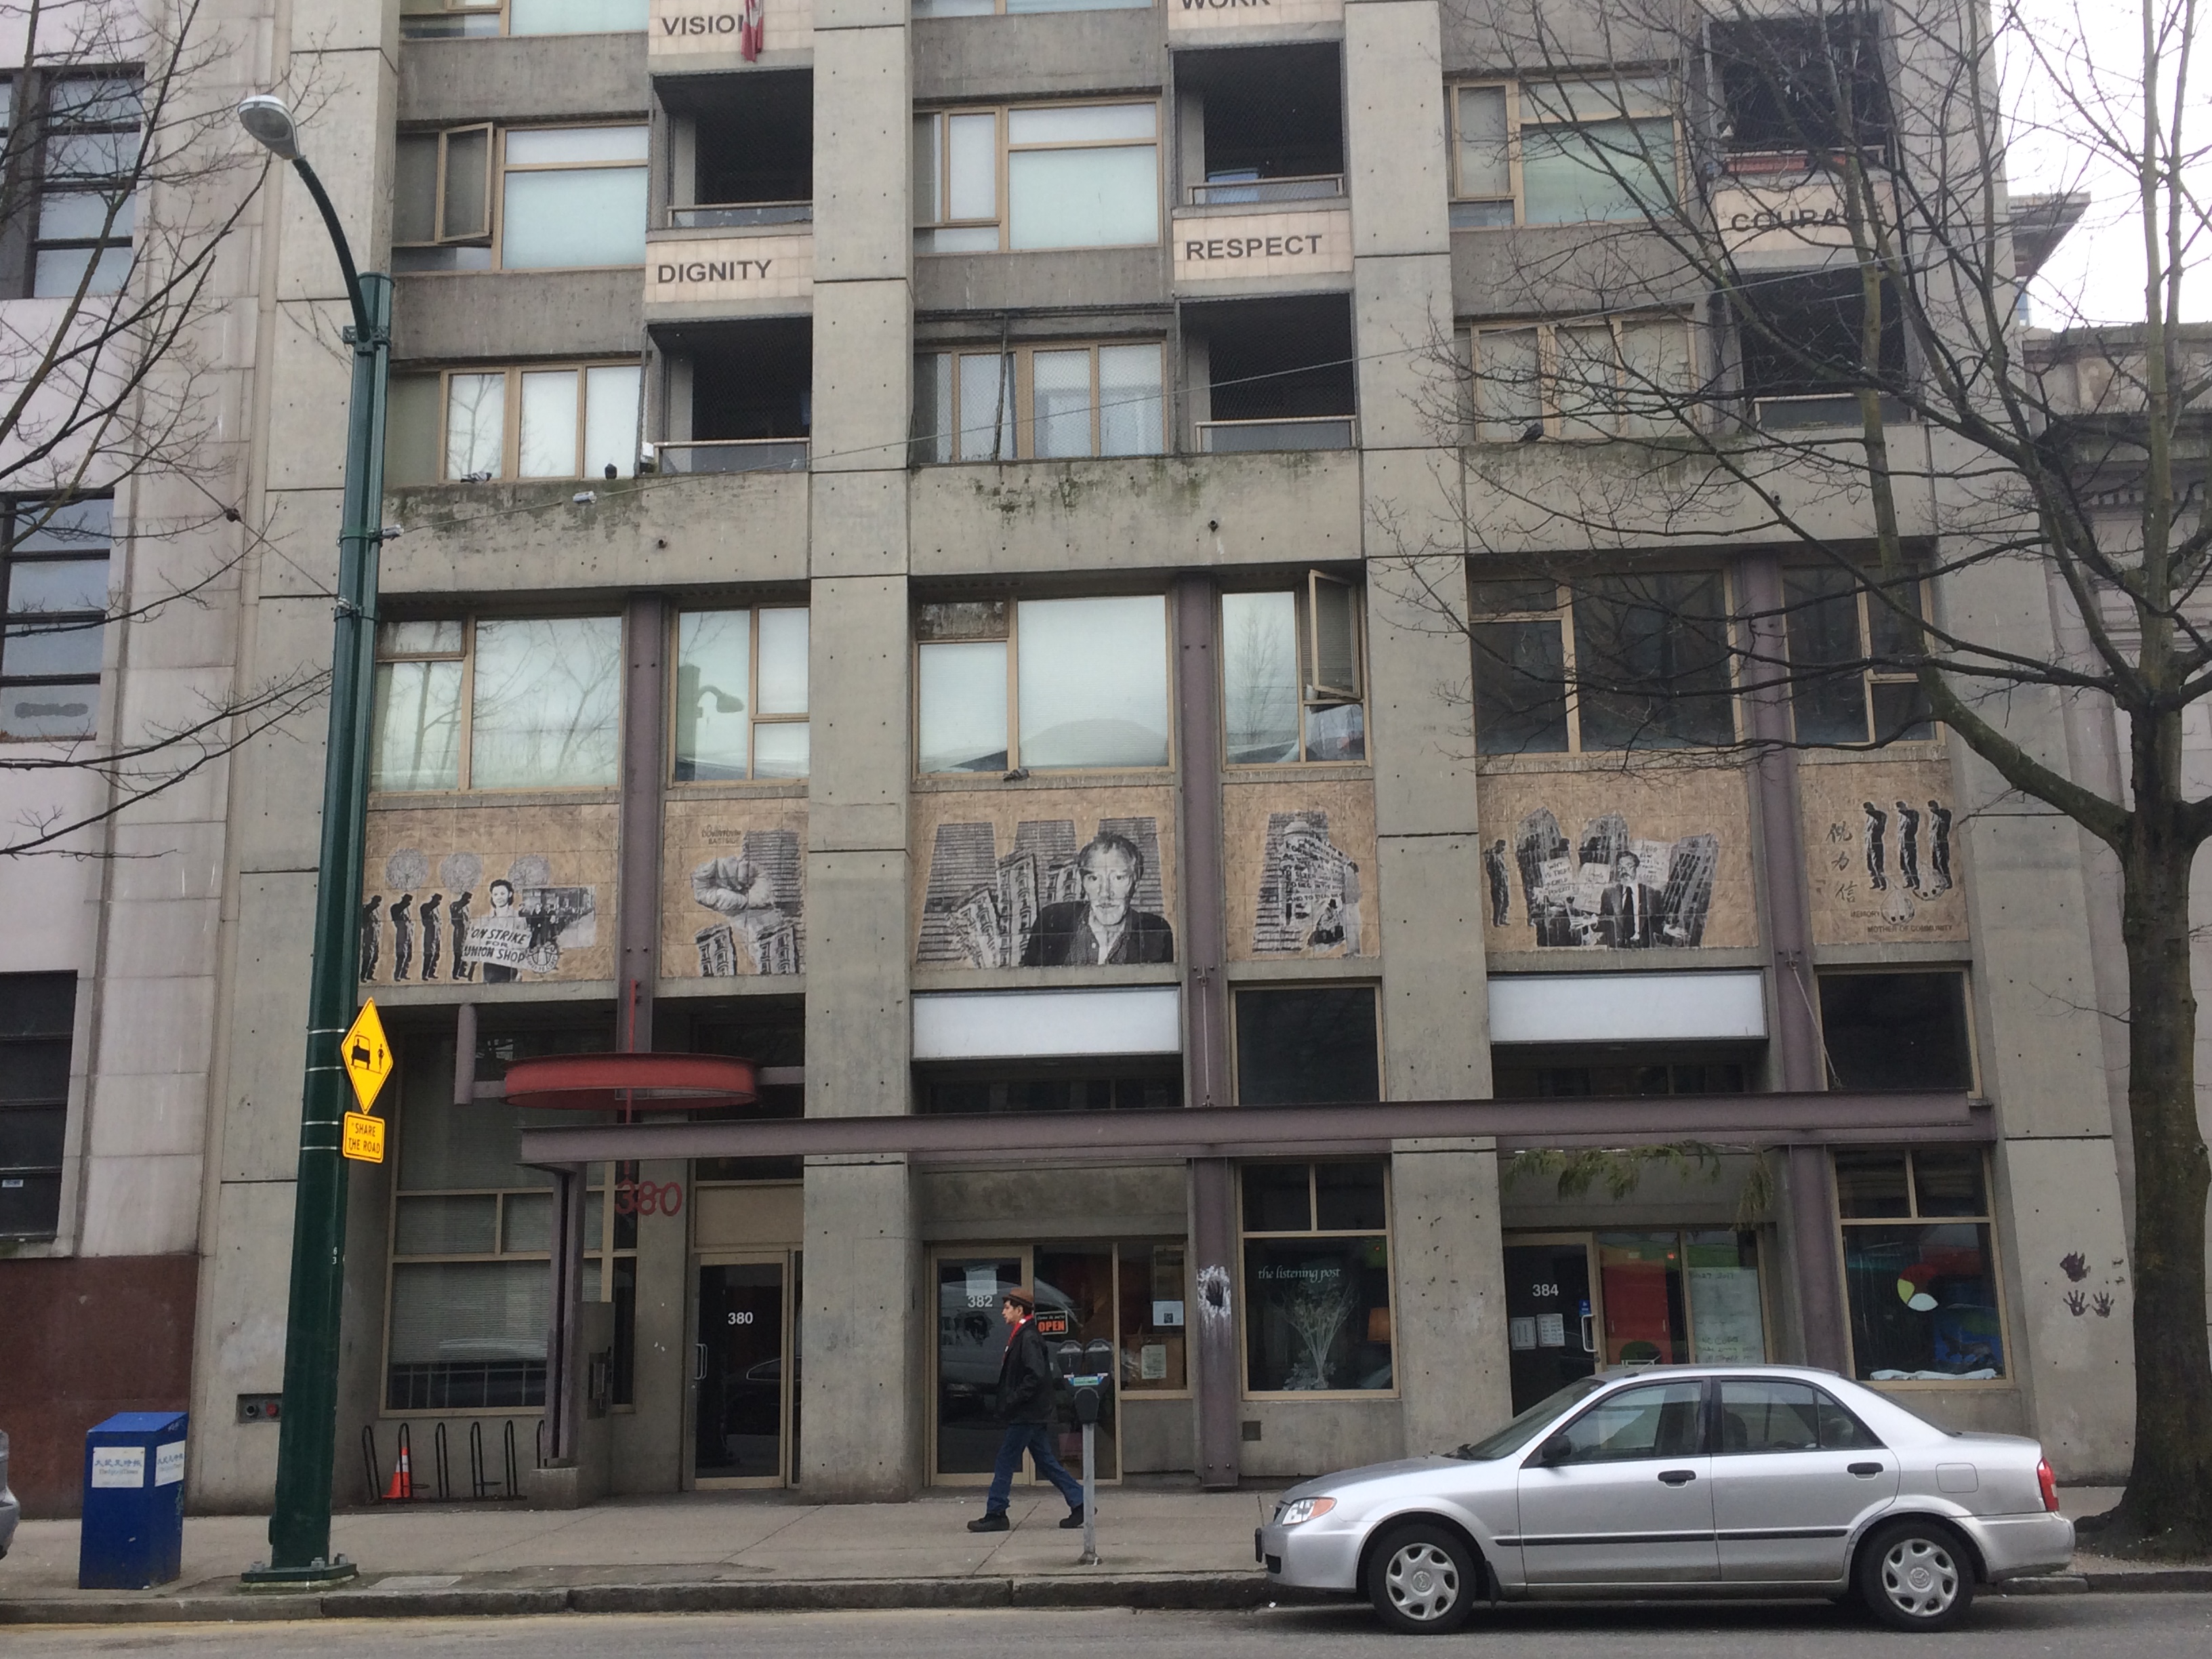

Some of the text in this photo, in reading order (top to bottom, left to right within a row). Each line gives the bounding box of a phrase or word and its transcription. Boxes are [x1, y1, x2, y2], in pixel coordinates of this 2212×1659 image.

[661, 15, 743, 35] VISIO
[1732, 205, 1887, 231] COURAE
[1186, 234, 1322, 260] RESPECT
[658, 260, 772, 283] DIGNITY
[464, 946, 525, 963] UNION SHOP
[354, 1123, 376, 1137] SHARE
[348, 1138, 380, 1154] THE ROAD
[615, 1179, 683, 1217] 380
[1258, 1265, 1341, 1284] the listening post
[1532, 1284, 1559, 1297] 384
[968, 1295, 993, 1308] 382
[728, 1312, 754, 1325] 380
[1038, 1320, 1065, 1332] OPEN
